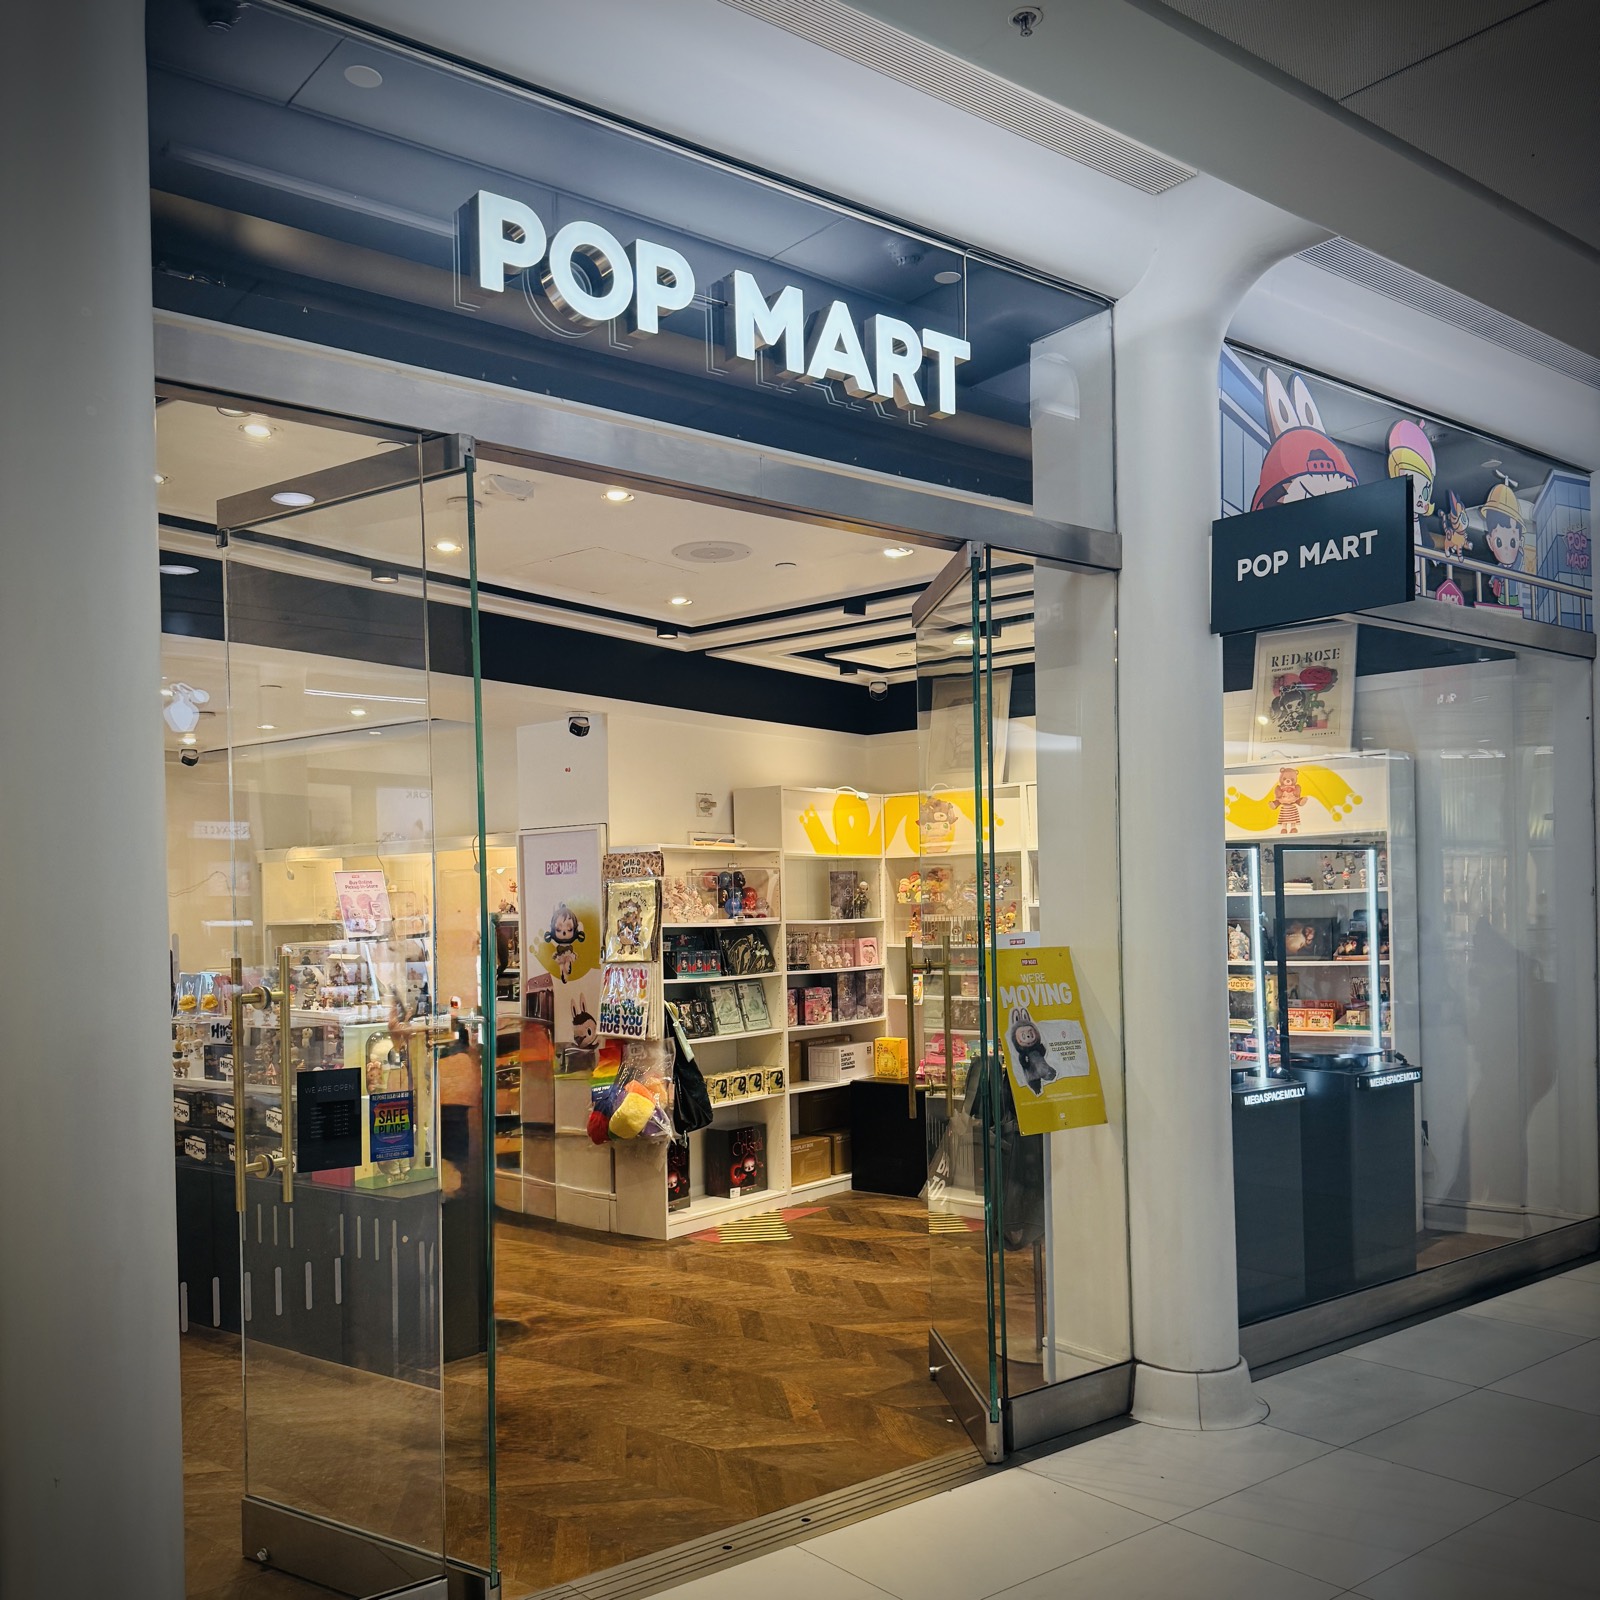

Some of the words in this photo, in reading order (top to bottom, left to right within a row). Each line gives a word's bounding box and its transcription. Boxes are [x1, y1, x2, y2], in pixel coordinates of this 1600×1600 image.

[476, 189, 696, 336] POP
[732, 268, 971, 416] MART
[1566, 531, 1588, 551] POP
[1236, 549, 1289, 582] POP
[1299, 530, 1379, 569] MART
[1565, 551, 1590, 570] MART
[1271, 653, 1301, 668] RED
[546, 862, 559, 873] POP
[559, 861, 577, 873] MART
[621, 867, 642, 876] CUTIE
[1020, 972, 1046, 983] WE'RE
[999, 982, 1073, 1009] MOVING
[600, 1003, 621, 1014] HUG
[621, 1004, 645, 1016] YOU
[600, 1013, 621, 1025] HUG
[622, 1015, 643, 1026] YOU
[600, 1023, 620, 1034] HUG
[621, 1024, 643, 1036] YOU
[304, 1086, 316, 1094] WE
[317, 1085, 332, 1093] ARE
[333, 1083, 354, 1092] OPEN
[378, 1108, 406, 1124] SAFE
